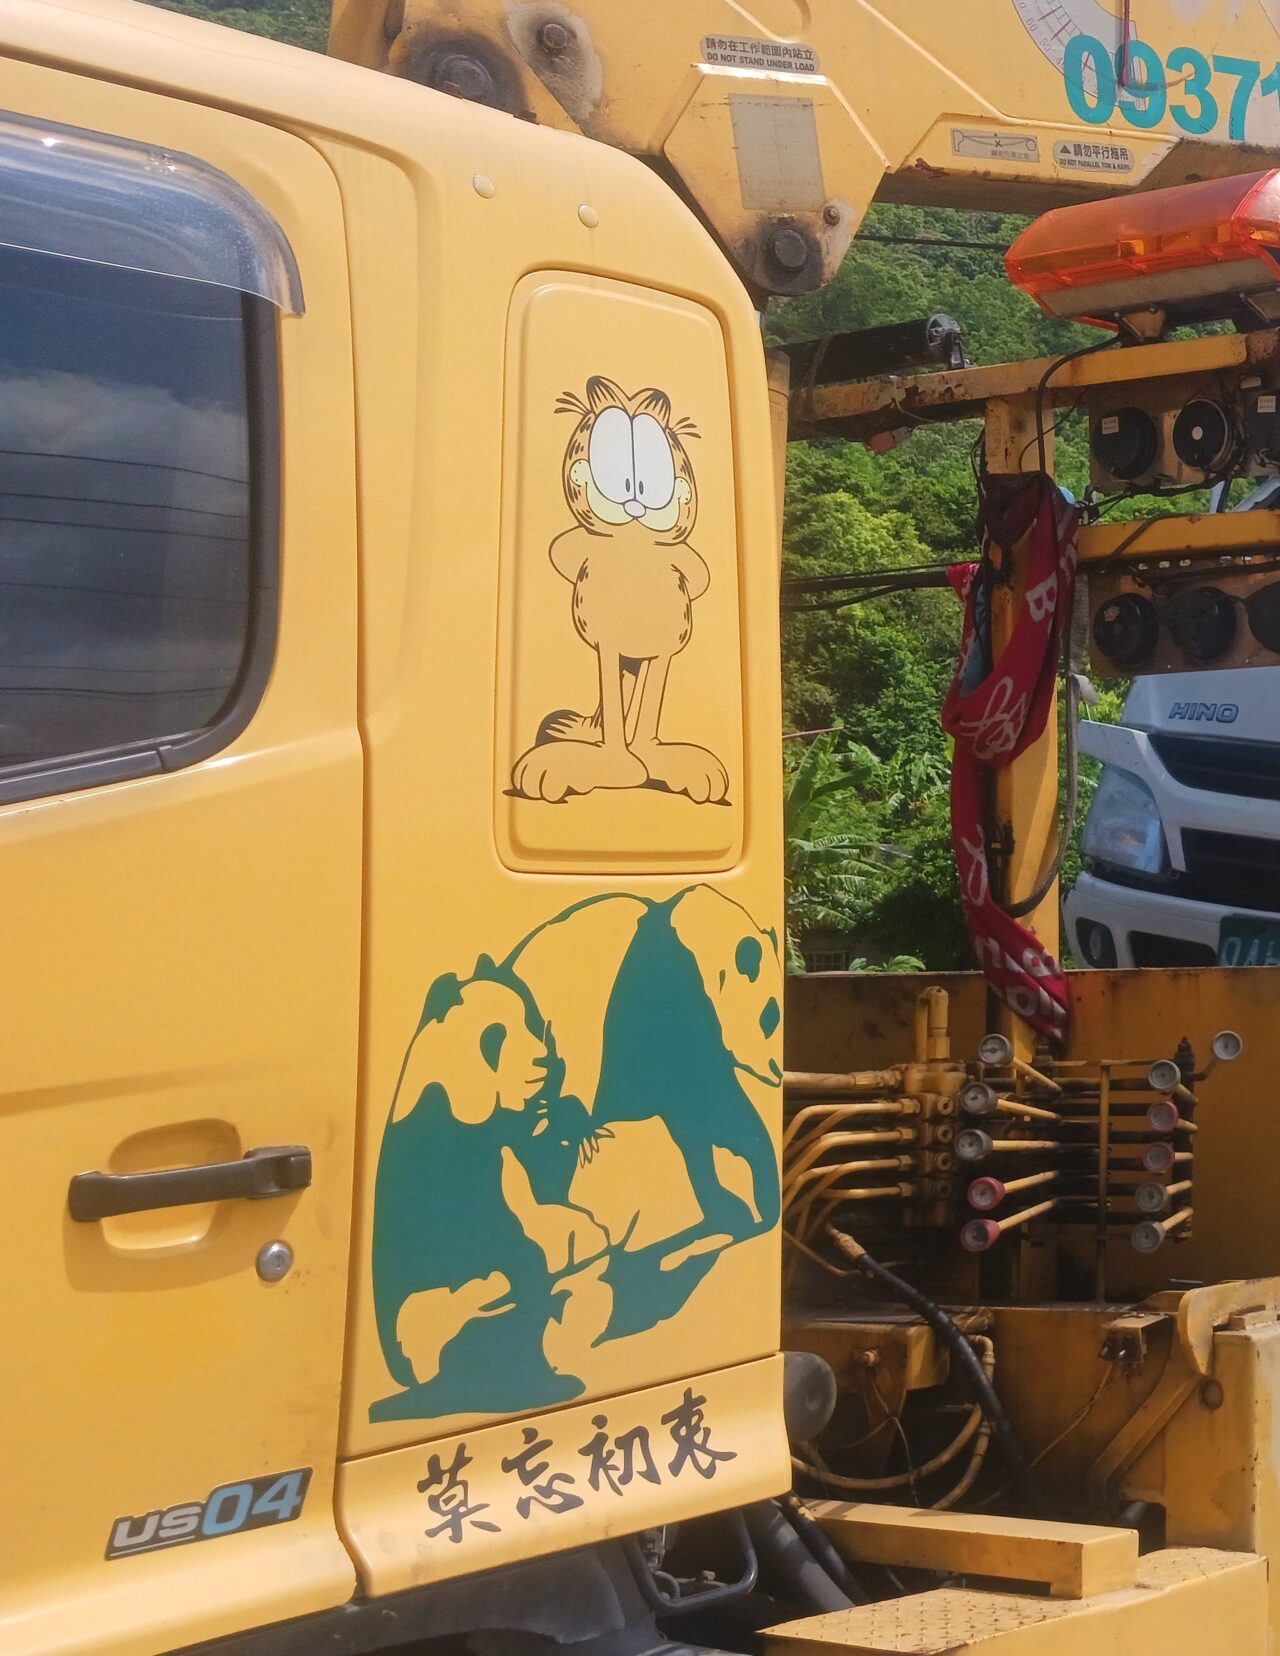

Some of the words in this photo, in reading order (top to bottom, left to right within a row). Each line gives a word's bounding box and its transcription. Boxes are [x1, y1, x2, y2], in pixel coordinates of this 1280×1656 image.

[705, 38, 814, 61] 請勿在工作範圍內站立
[707, 52, 719, 61] DO
[720, 53, 737, 63] NOT
[739, 56, 765, 66] STAND
[767, 59, 793, 69] UNDER
[795, 62, 815, 72] LOAD
[1073, 143, 1129, 161] 請勿平行拖吊
[1168, 702, 1240, 724] HINO
[112, 1474, 304, 1548] US04
